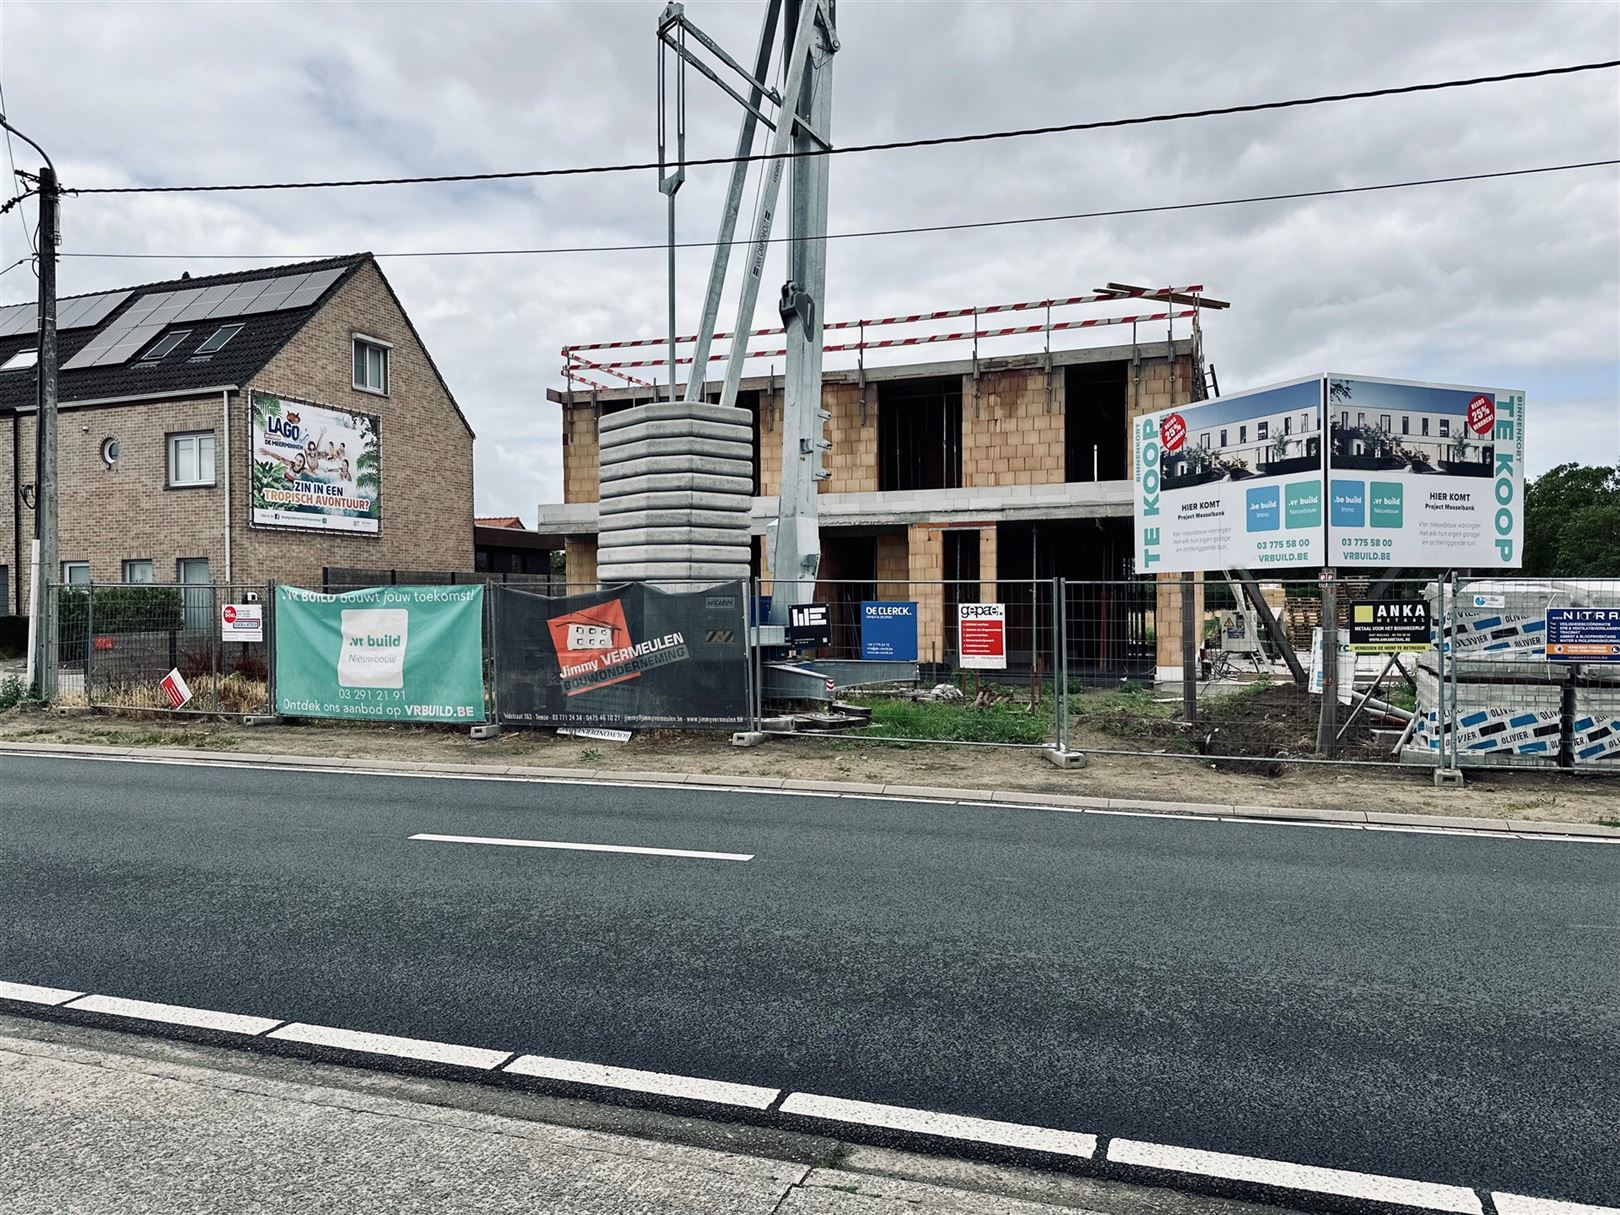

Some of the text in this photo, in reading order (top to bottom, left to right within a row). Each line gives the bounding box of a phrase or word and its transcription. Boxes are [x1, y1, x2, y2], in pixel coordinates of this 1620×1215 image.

[1472, 404, 1490, 422] 25%
[268, 416, 300, 441] LAGO
[1165, 422, 1182, 442] 25%
[1494, 396, 1514, 562] TE KOOP
[294, 481, 344, 496] ZIN IN EEN
[1142, 418, 1160, 568] TE KOOP
[264, 490, 370, 510] TROPISCH AVONTUUR?
[1300, 496, 1318, 505] build
[1346, 496, 1362, 504] build
[1384, 497, 1400, 505] build
[1430, 492, 1471, 502] HIER KOMT
[1181, 500, 1220, 511] HIER KOMT
[1260, 501, 1277, 509] build
[1299, 539, 1310, 547] 00
[1258, 553, 1308, 562] VRBUILD.BE
[1343, 552, 1391, 560] VRBUILD.BE
[382, 590, 411, 606] jouw
[414, 590, 475, 602] toekomst!
[866, 607, 912, 616] DE CLERCK.
[1377, 604, 1425, 617] ANKA
[349, 635, 400, 647] .vr build
[1514, 637, 1541, 647] OLIVIER
[348, 654, 398, 664] Nieuwbouw
[560, 631, 684, 678] Jimmy VERMEULEN
[563, 647, 686, 690] BOUWONDERNEMING
[338, 689, 406, 701] 03 291 21 91
[283, 698, 474, 718] Ontdek ons aanbod op VRBUILD.BE
[1501, 730, 1529, 744] OLIVIER
